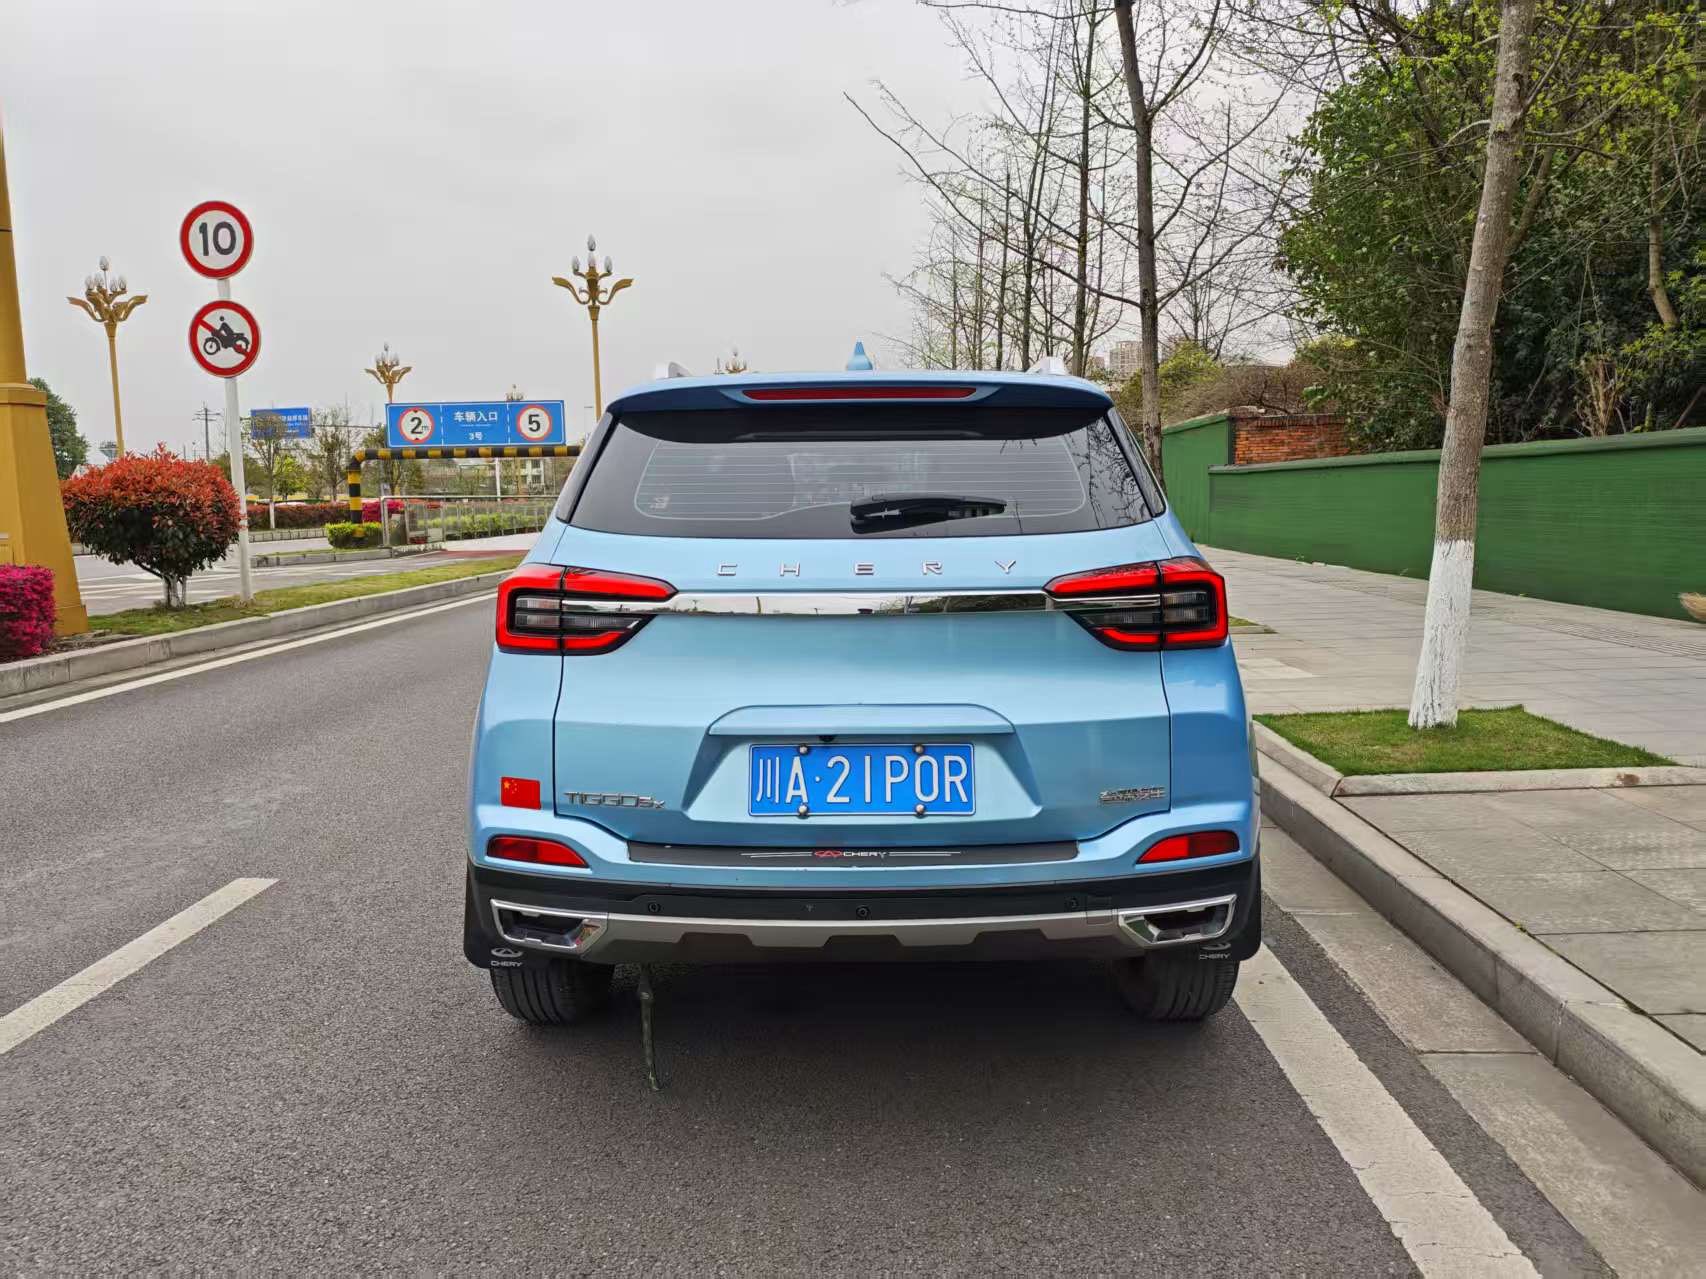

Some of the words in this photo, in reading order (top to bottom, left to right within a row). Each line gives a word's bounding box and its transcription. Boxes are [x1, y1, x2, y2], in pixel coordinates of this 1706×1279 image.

[199, 221, 237, 256] 10
[453, 411, 499, 423] 车辆入口
[527, 414, 541, 432] 5
[468, 431, 484, 441] 3号
[716, 559, 1017, 577] CHERY
[843, 851, 887, 859] CHERY
